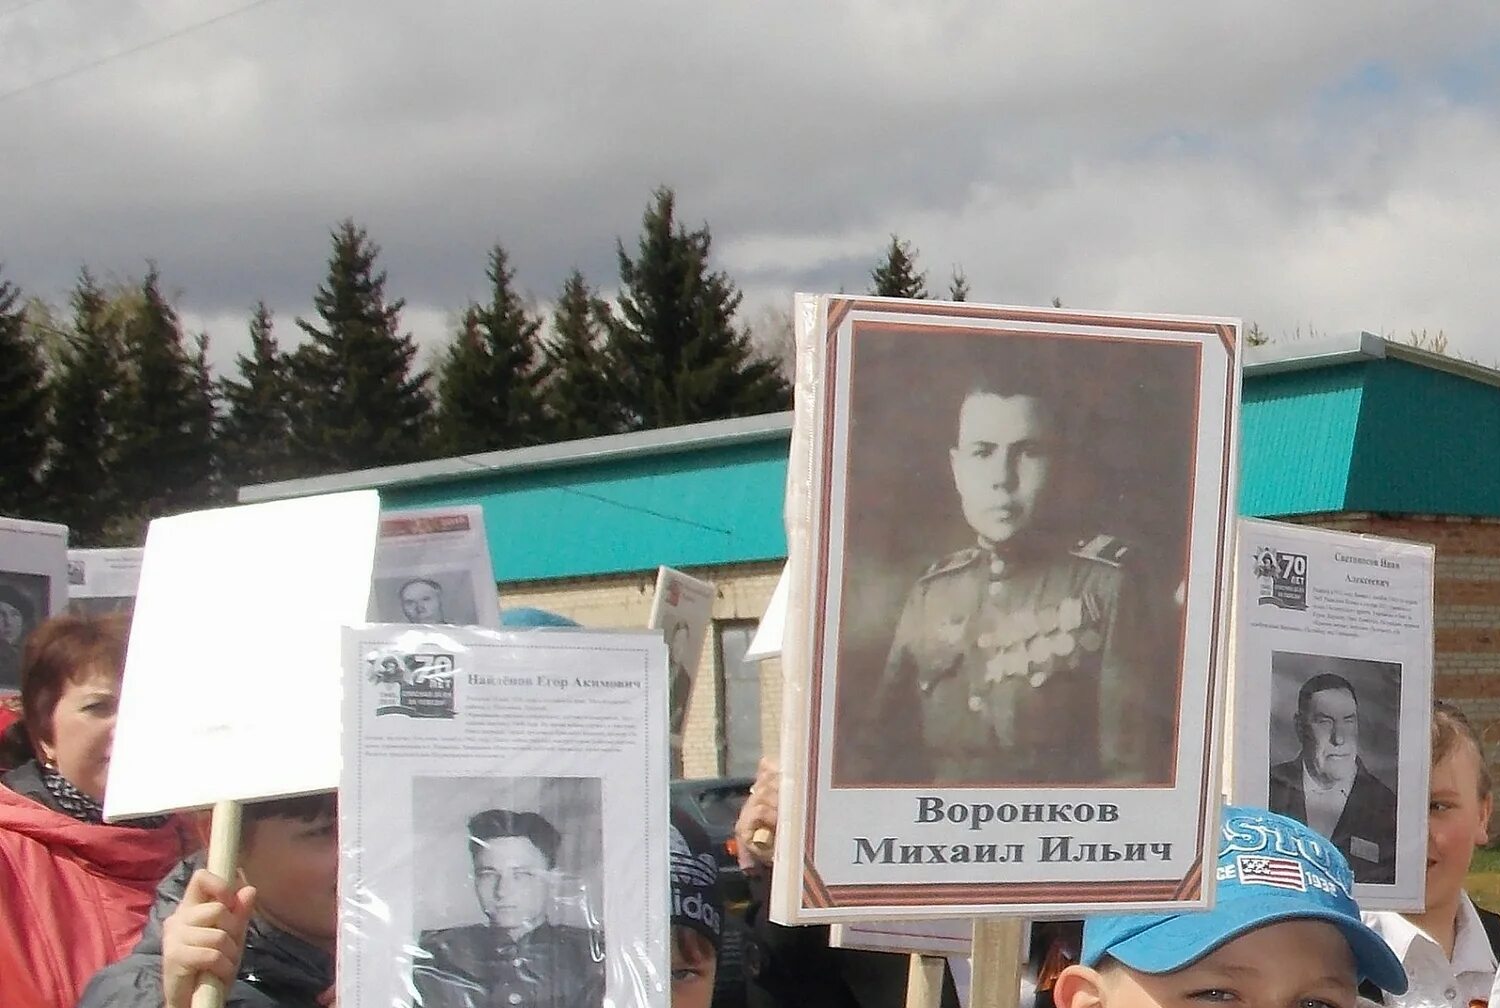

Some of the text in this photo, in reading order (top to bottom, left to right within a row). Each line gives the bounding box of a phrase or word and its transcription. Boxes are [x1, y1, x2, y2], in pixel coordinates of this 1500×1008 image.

[1281, 554, 1306, 580] 70
[537, 676, 569, 690] Егор
[574, 676, 642, 690] Акимович
[914, 796, 1120, 831] Воронков
[852, 835, 1174, 865] Михаил Ильич
[672, 887, 720, 936] idas
